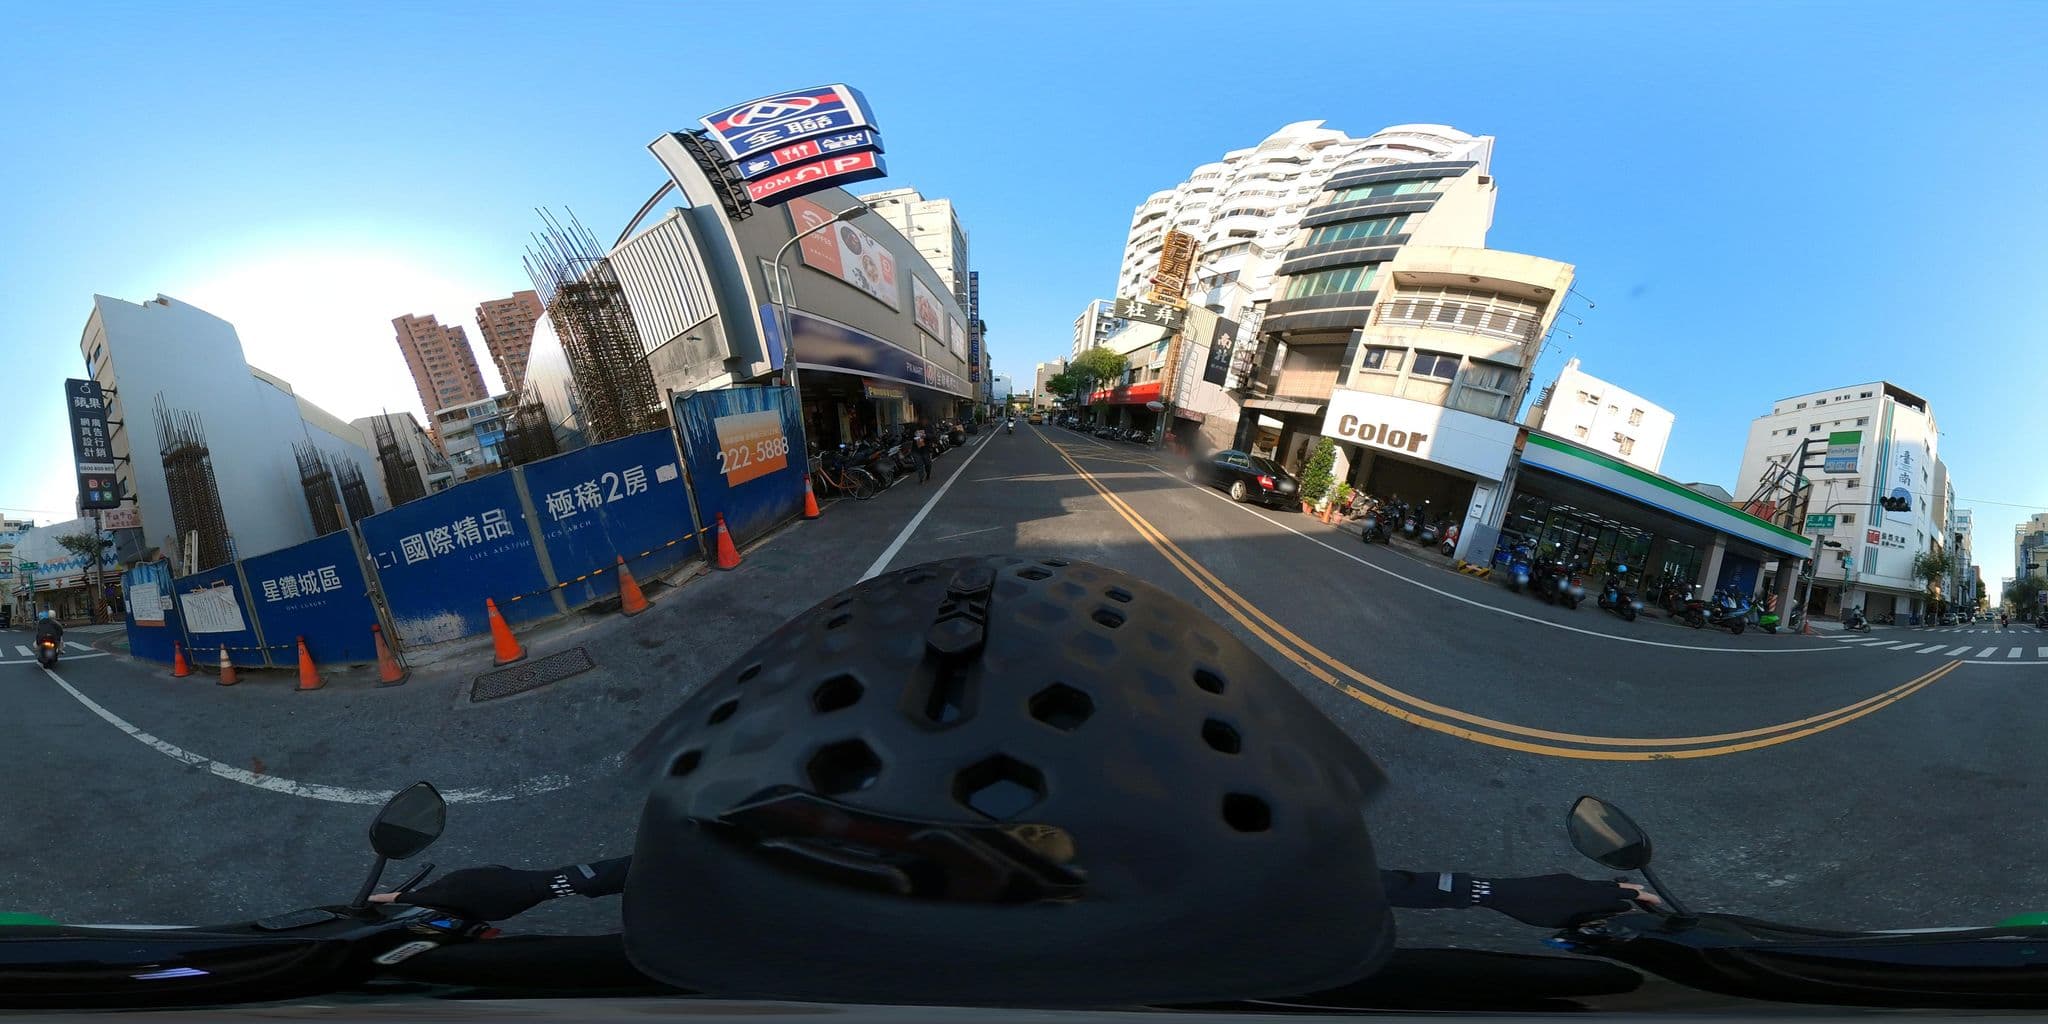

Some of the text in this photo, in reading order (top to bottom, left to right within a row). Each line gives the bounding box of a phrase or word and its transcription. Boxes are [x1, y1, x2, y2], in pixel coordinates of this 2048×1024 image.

[744, 114, 833, 147] 全聯
[822, 132, 863, 149] ATM
[833, 157, 861, 172] P
[752, 176, 791, 194] 70M
[1124, 301, 1175, 324] 杜拜
[74, 396, 101, 409] 蘋果
[91, 418, 107, 458] 廣告行銷
[1338, 414, 1428, 452] Color
[716, 436, 789, 475] 222-5888
[545, 465, 648, 521] 極稀2房
[399, 508, 511, 565] 國際精品
[262, 565, 342, 602] 星鑽城區
